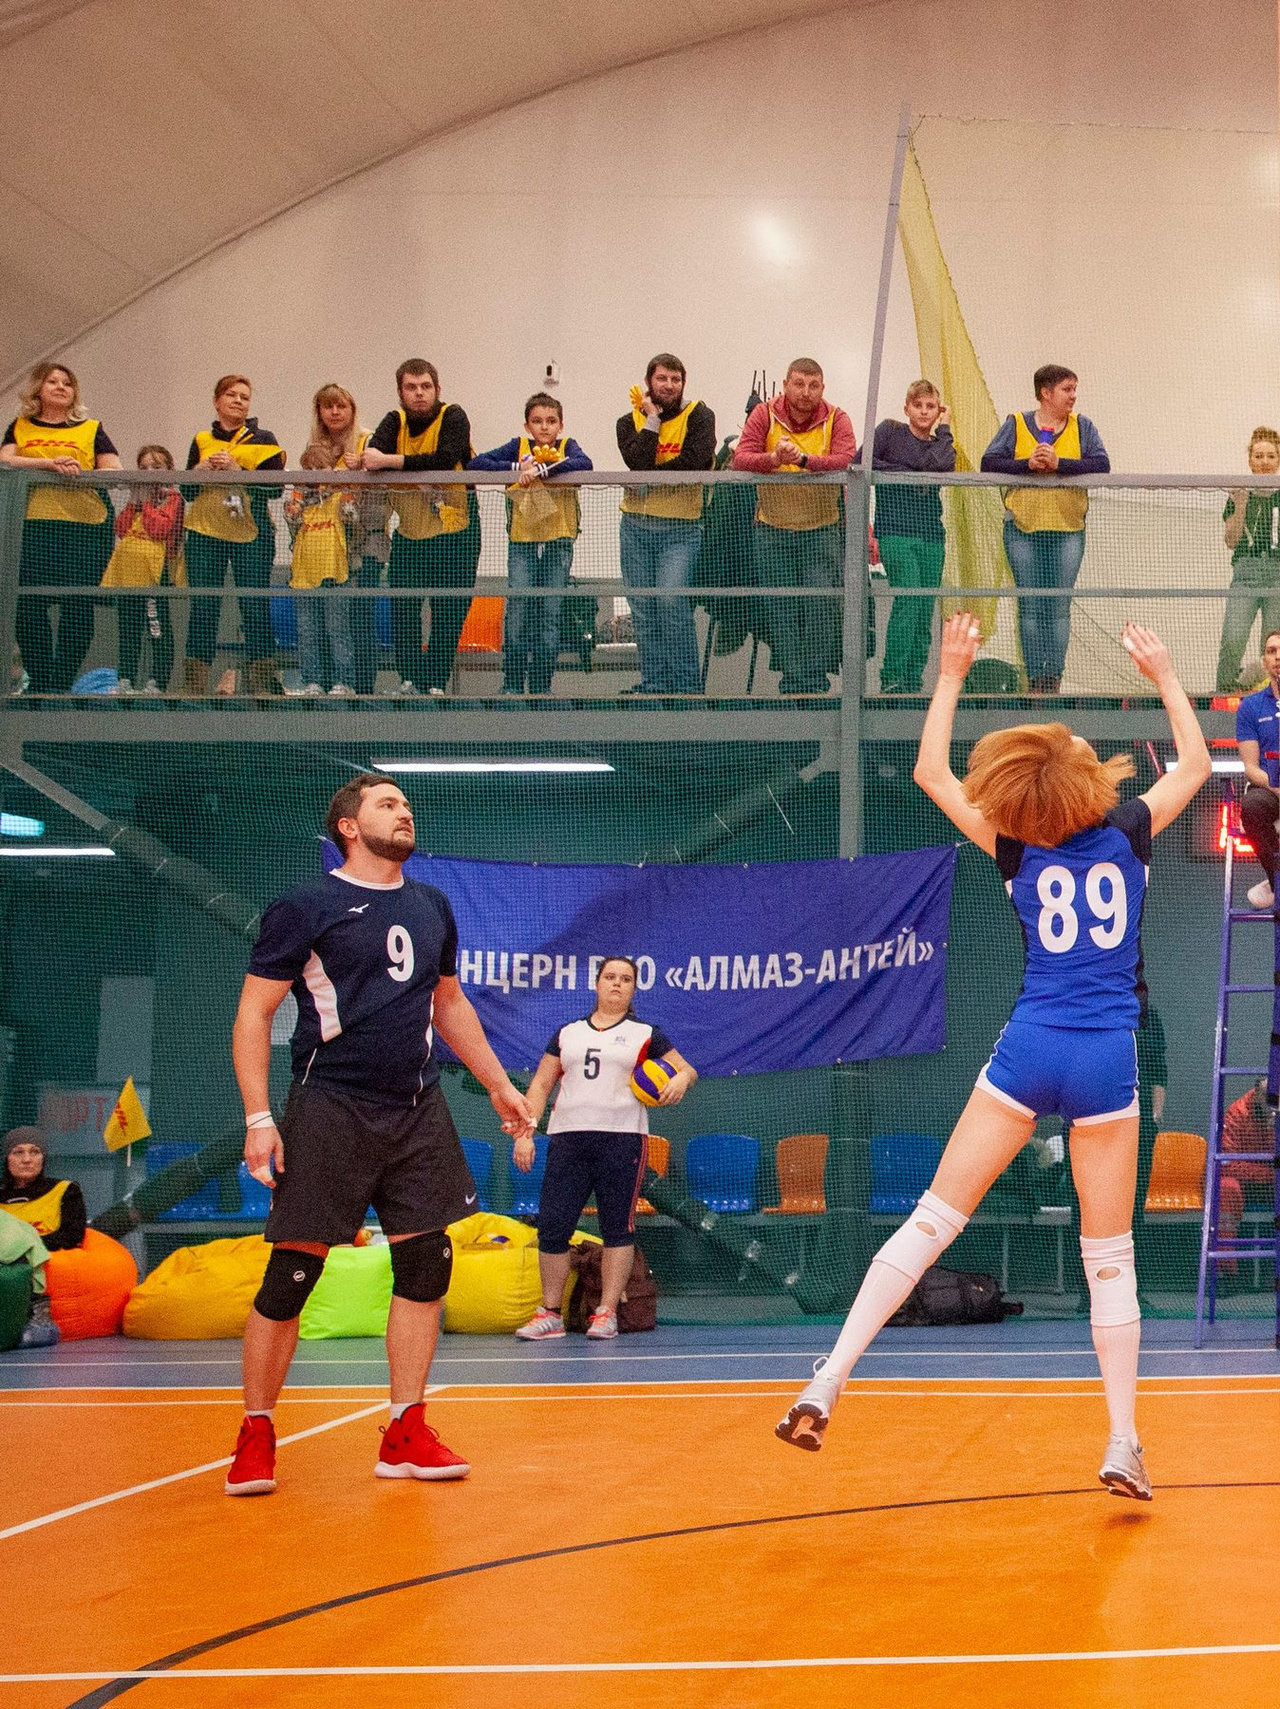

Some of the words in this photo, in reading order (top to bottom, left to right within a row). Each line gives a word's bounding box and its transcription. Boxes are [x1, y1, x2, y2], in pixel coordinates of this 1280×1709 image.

[656, 442, 681, 453] HL
[1036, 862, 1128, 954] 89
[386, 924, 415, 982] 9
[456, 949, 578, 994] НЦЕРН
[664, 926, 935, 991] «АЛМАЗ-АНТЕЙ»
[583, 1047, 602, 1080] 5
